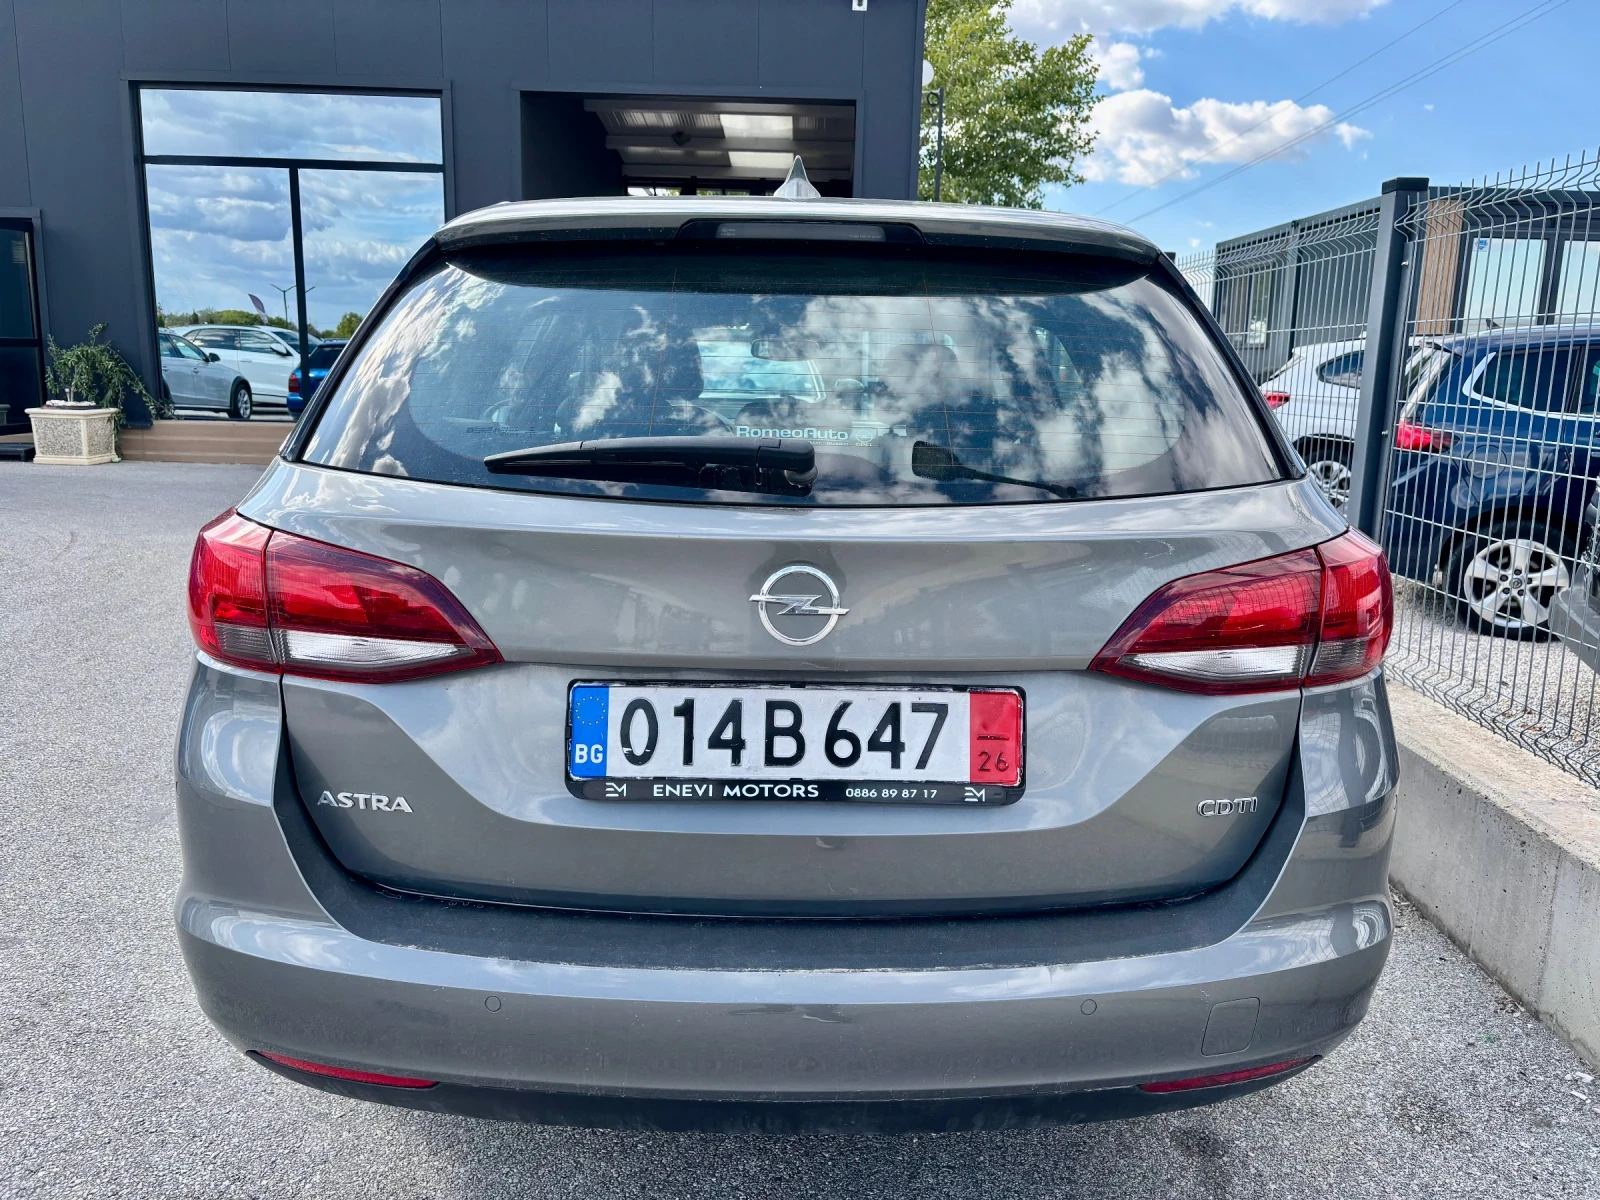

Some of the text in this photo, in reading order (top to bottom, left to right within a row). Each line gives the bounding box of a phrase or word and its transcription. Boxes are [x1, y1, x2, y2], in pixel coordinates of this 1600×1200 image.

[736, 426, 849, 440] RomeoAuto
[575, 743, 603, 764] BG
[977, 751, 1009, 772] 26
[317, 790, 413, 813] ASTRA
[653, 784, 819, 798] ENEVI MOTORS
[845, 788, 937, 799] 0886 89 87 17
[1197, 796, 1258, 817] CDTI
